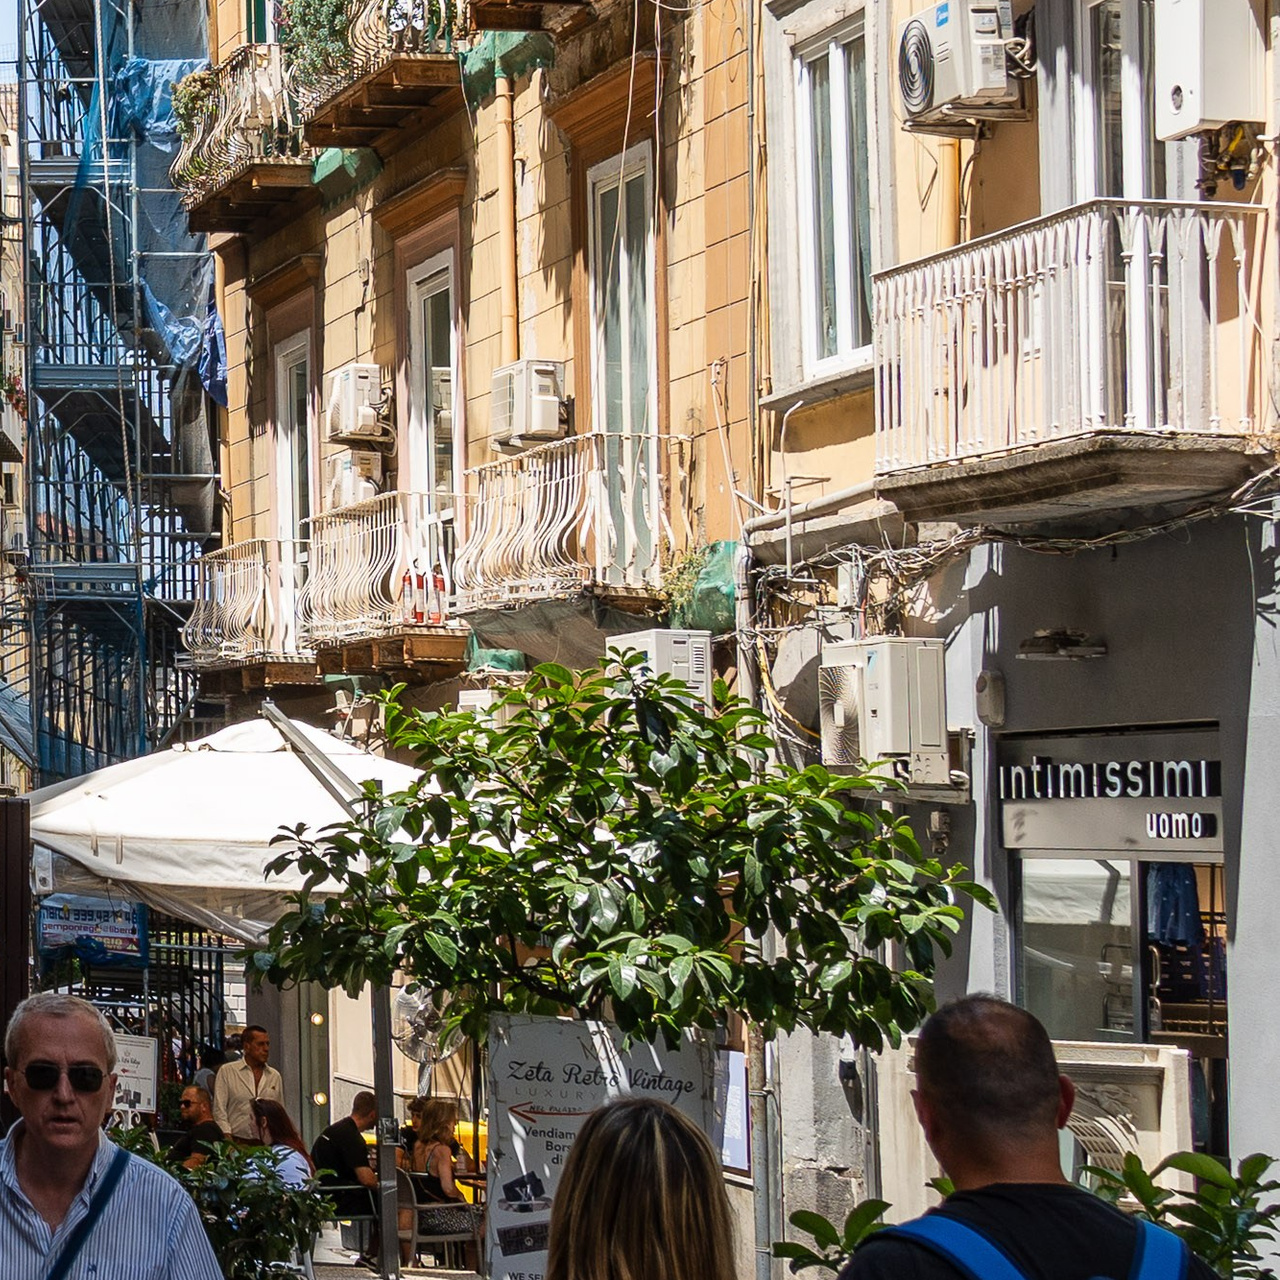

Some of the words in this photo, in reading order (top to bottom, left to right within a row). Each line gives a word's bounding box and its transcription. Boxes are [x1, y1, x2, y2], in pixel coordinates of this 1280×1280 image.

[999, 759, 1210, 801] intimissimi
[1146, 811, 1203, 839] uomo
[507, 1060, 554, 1084] Zeta
[563, 1063, 619, 1087] Retrò
[627, 1067, 696, 1105] Vintage
[523, 1125, 577, 1140] Vendiam
[551, 1154, 563, 1165] di
